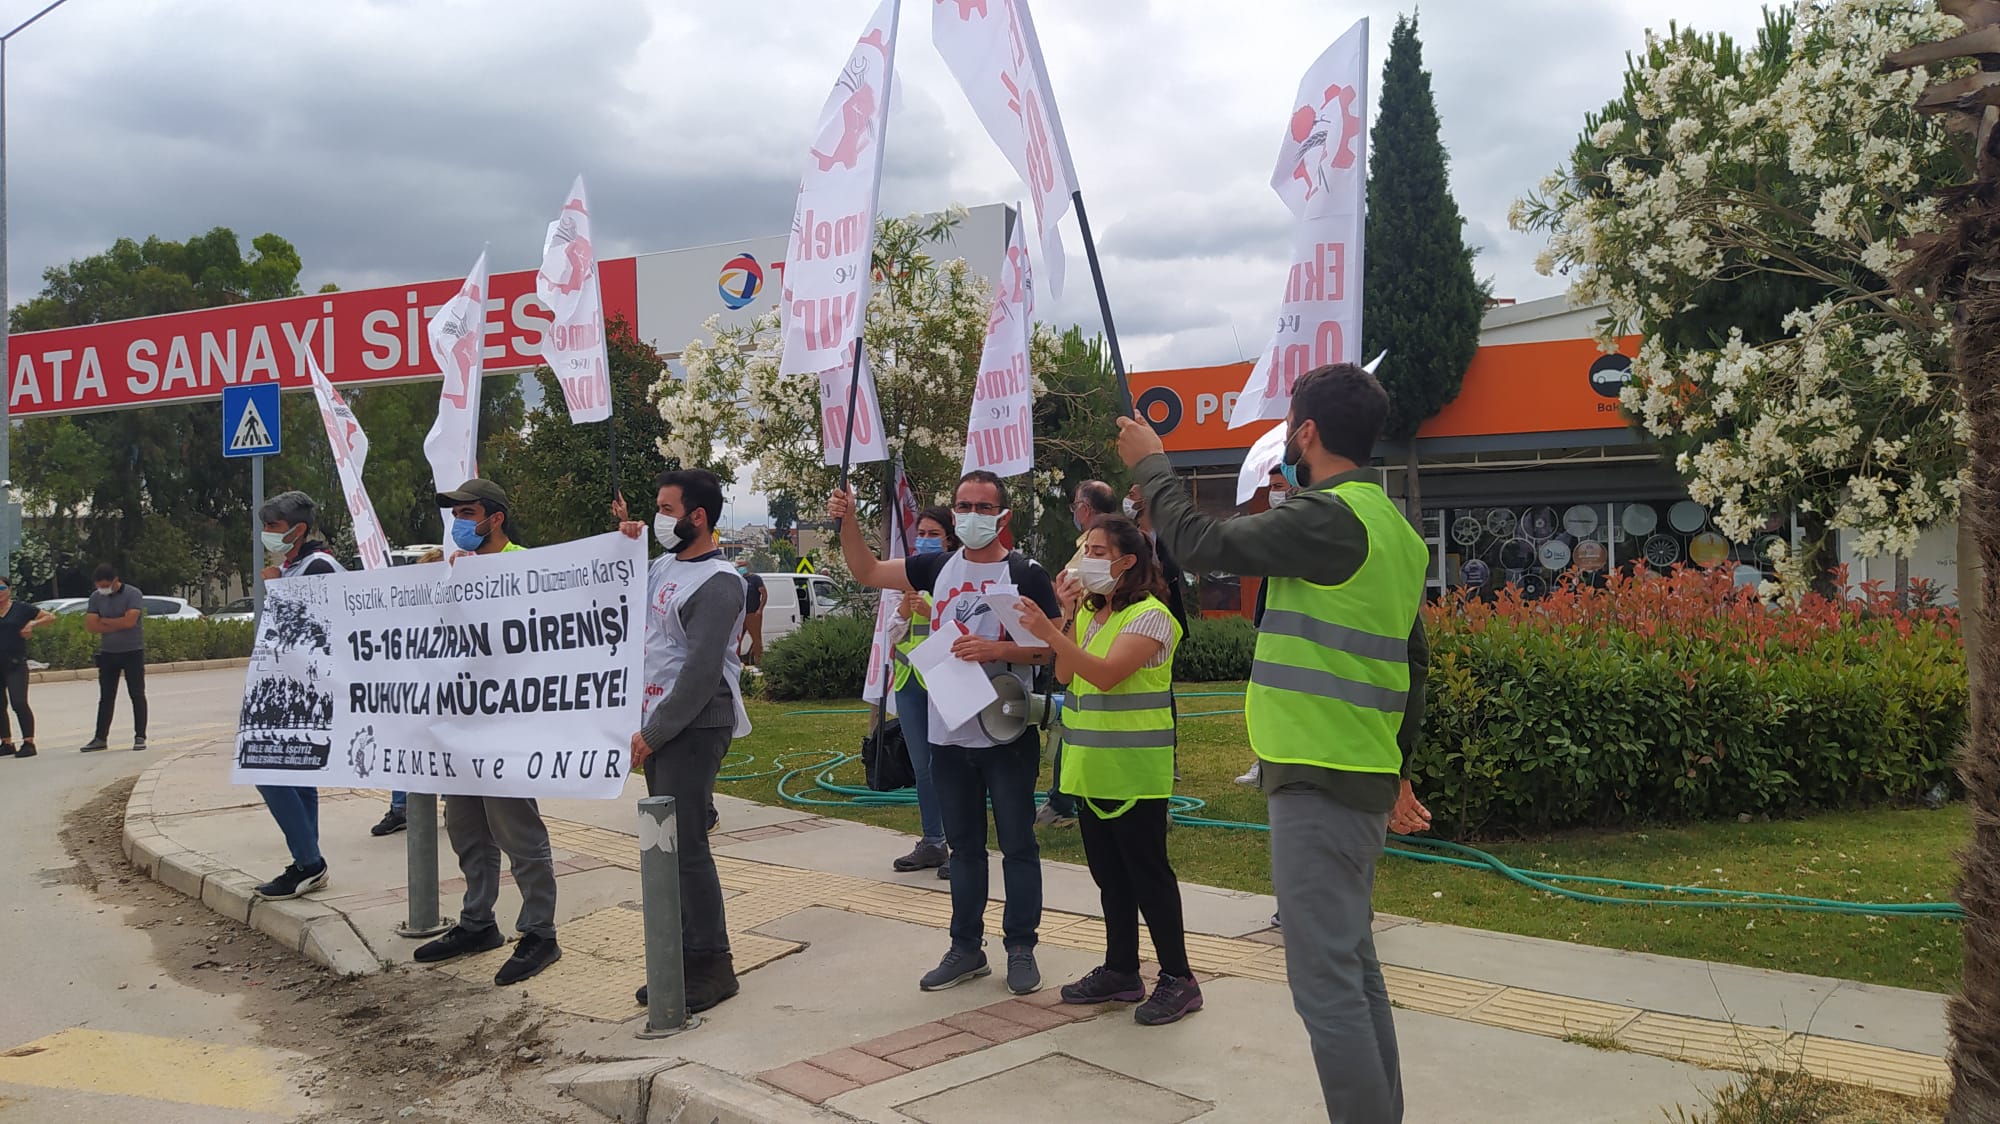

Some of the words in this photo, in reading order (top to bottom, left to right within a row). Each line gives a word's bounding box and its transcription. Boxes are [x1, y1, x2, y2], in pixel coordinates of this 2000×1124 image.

[9, 346, 108, 407] ATA
[126, 301, 335, 395] SANAYİ
[343, 585, 388, 617] İşsizlik,
[591, 559, 635, 587] Karşı
[348, 628, 402, 662] 15-16
[406, 617, 493, 660] HAZİRAN
[502, 594, 629, 657] DİRENİŞİ
[350, 682, 430, 715] RUHUYLA
[437, 667, 629, 716] MÜCADELEYE!
[383, 748, 457, 778] EKMEK
[472, 758, 505, 780] ve
[527, 750, 622, 780] ONUR
